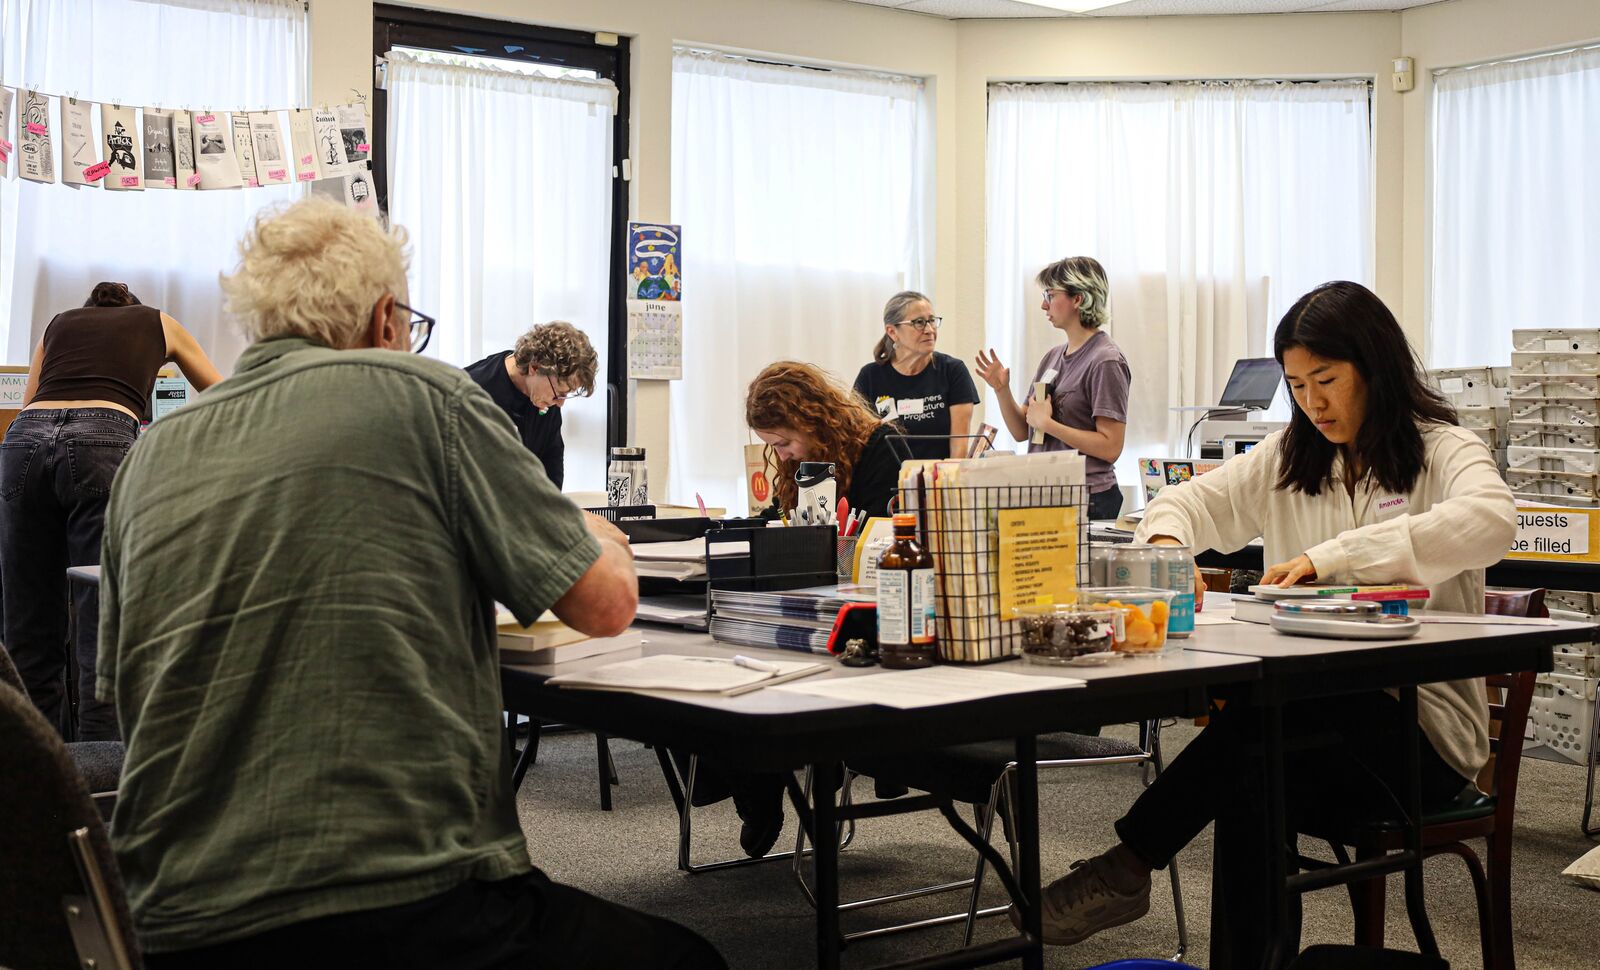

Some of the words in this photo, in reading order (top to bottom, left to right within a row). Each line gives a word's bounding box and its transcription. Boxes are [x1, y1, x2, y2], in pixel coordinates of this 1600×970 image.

[646, 302, 666, 312] june
[3, 391, 25, 400] NO
[904, 411, 935, 422] Project
[1518, 514, 1568, 530] quests
[1534, 537, 1571, 554] filled
